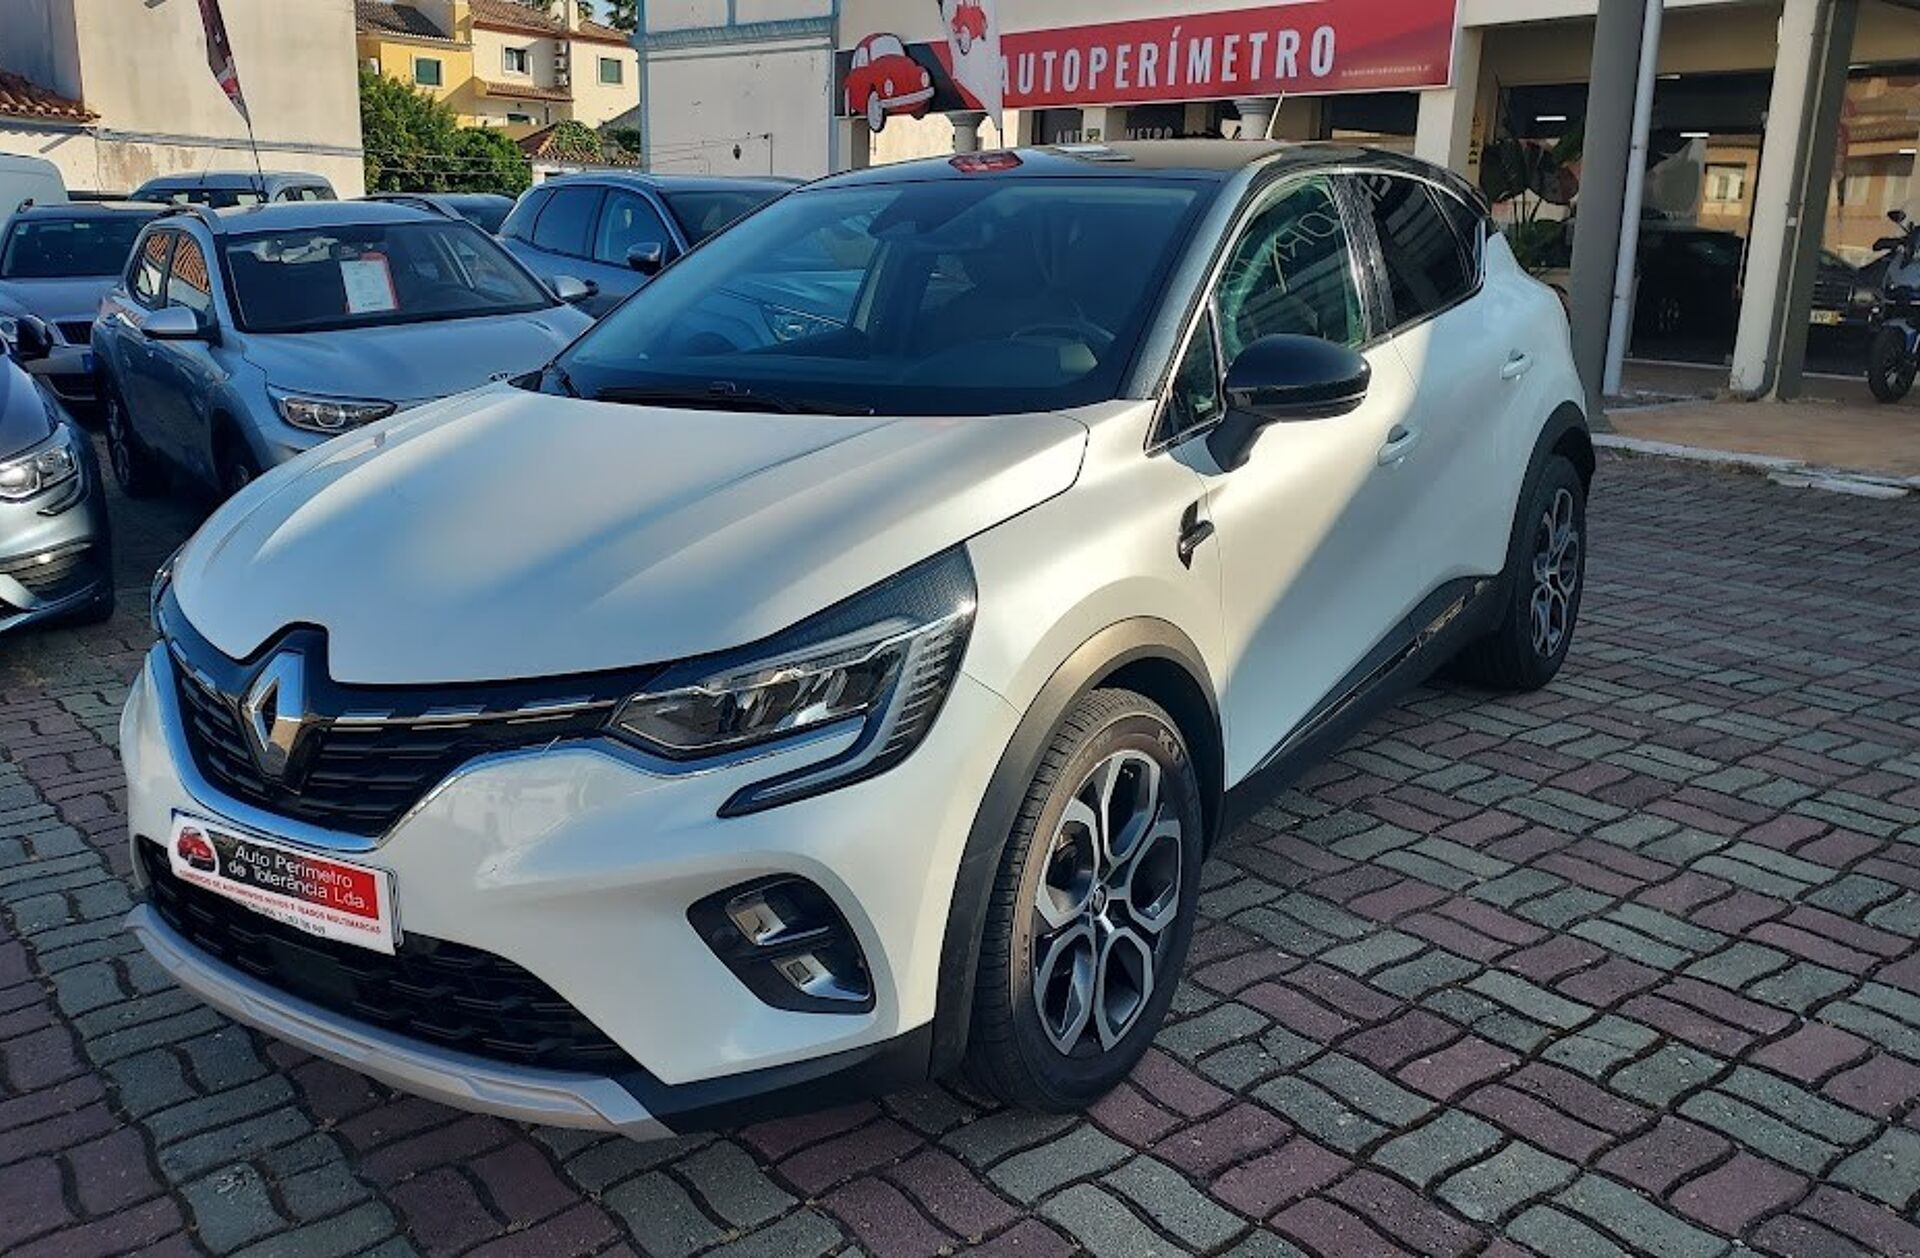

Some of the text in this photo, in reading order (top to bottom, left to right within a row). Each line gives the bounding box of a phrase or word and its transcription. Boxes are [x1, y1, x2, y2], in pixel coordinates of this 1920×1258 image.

[235, 845, 270, 867] Auto
[227, 861, 370, 910] de Tolerância Lda.
